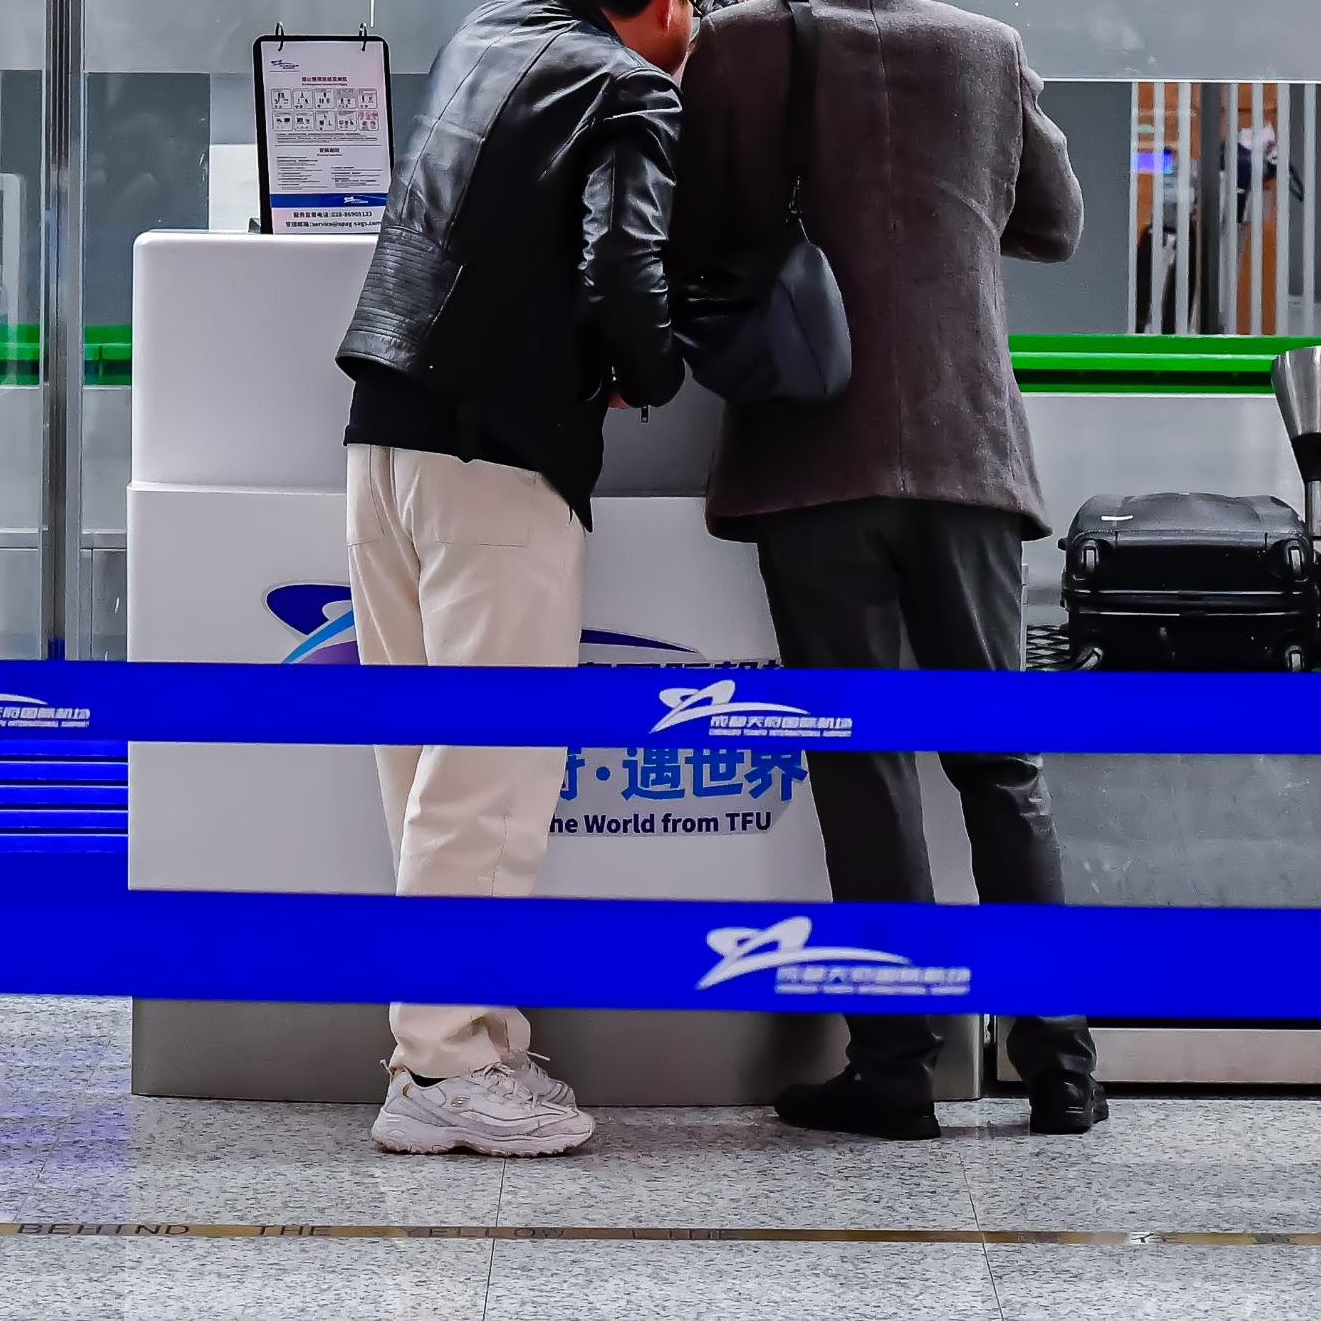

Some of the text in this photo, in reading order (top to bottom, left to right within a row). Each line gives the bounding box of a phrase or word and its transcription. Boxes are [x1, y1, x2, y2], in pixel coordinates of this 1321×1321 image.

[550, 811, 772, 834] he World from TFU
[17, 1222, 191, 1235] BEHIND
[254, 1224, 332, 1237] THE
